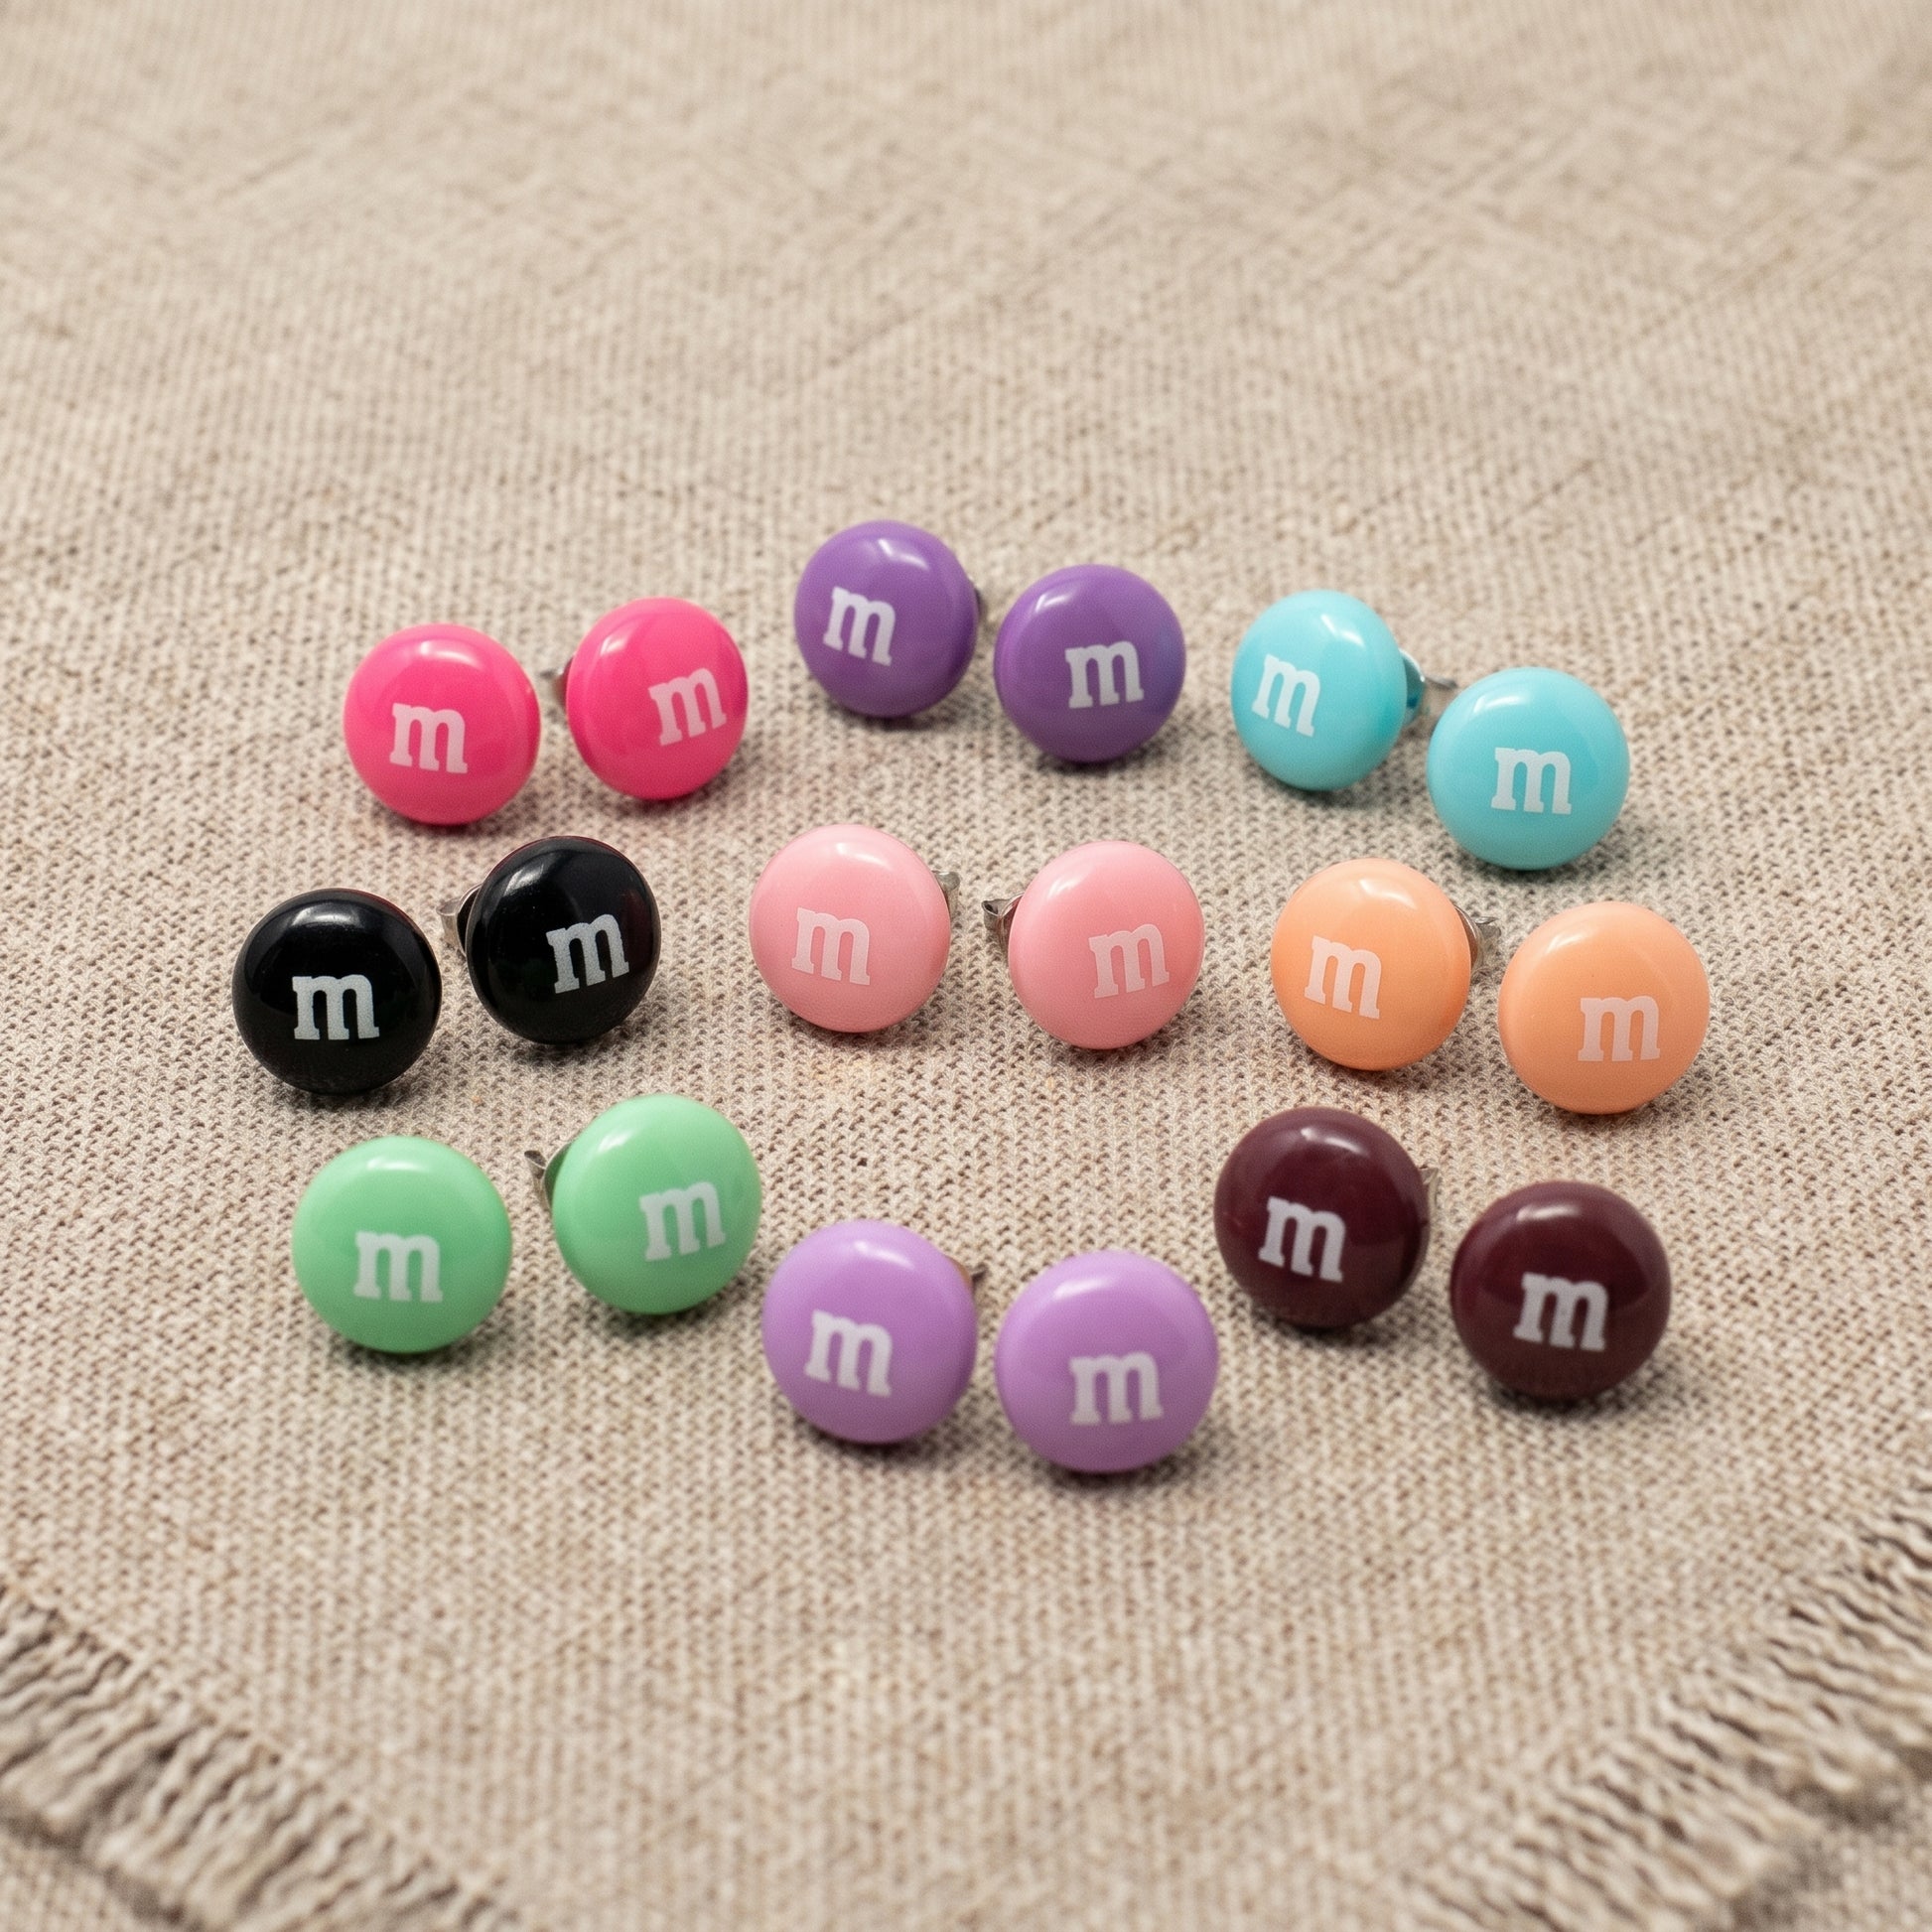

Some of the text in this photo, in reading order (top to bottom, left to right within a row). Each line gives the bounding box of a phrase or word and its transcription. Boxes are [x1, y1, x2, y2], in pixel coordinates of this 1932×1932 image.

[824, 586, 895, 664] m
[648, 667, 726, 745] m
[1065, 641, 1143, 708] m
[1252, 651, 1320, 736] m
[389, 703, 467, 772] m
[1491, 747, 1571, 813] m
[546, 914, 628, 993] m
[791, 905, 871, 986] m
[1087, 922, 1170, 999] m
[1304, 934, 1381, 1018] m
[292, 975, 379, 1039] m
[1579, 996, 1660, 1060] m
[638, 1180, 724, 1259] m
[1259, 1196, 1345, 1281] m
[353, 1230, 442, 1301] m
[1514, 1273, 1607, 1350] m
[805, 1310, 892, 1394] m
[1069, 1351, 1162, 1424] m
